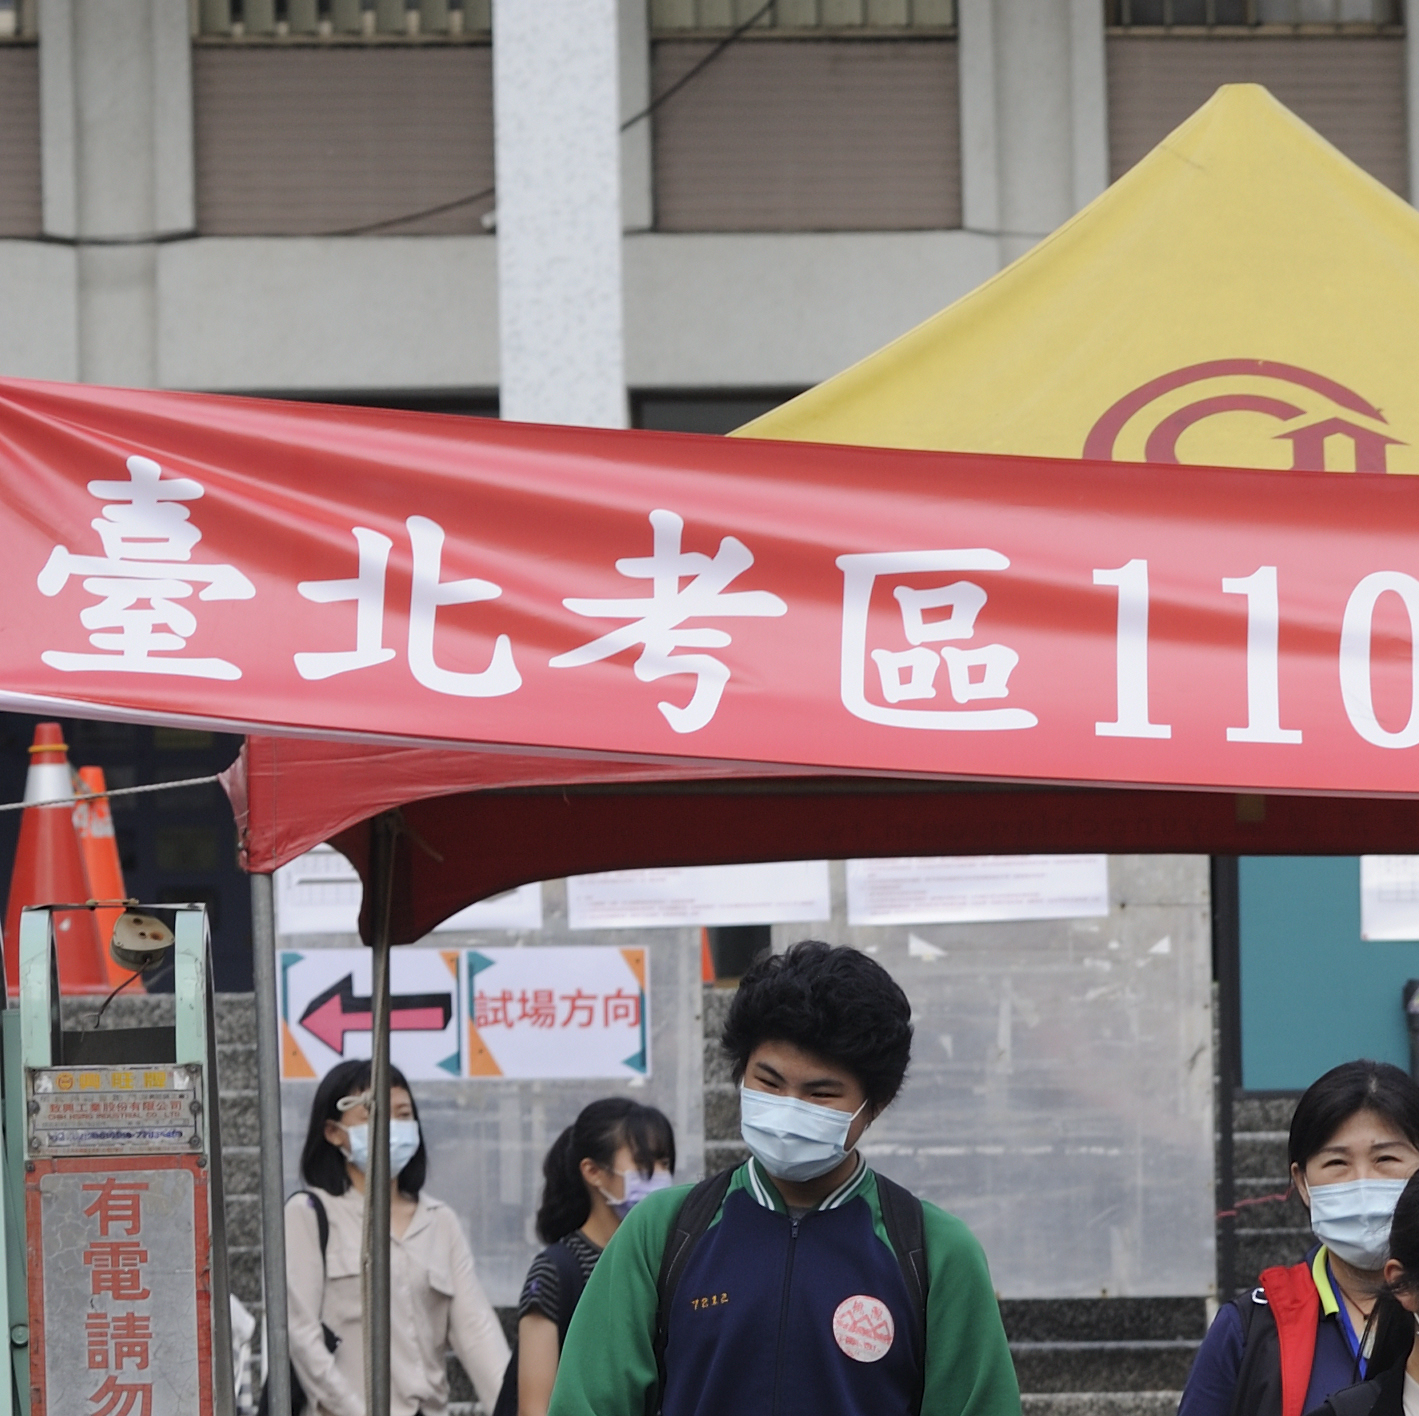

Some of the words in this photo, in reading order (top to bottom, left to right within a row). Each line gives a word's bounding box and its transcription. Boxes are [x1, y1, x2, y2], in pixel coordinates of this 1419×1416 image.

[474, 988, 641, 1029] 試場方向
[691, 1292, 729, 1311] 7212
